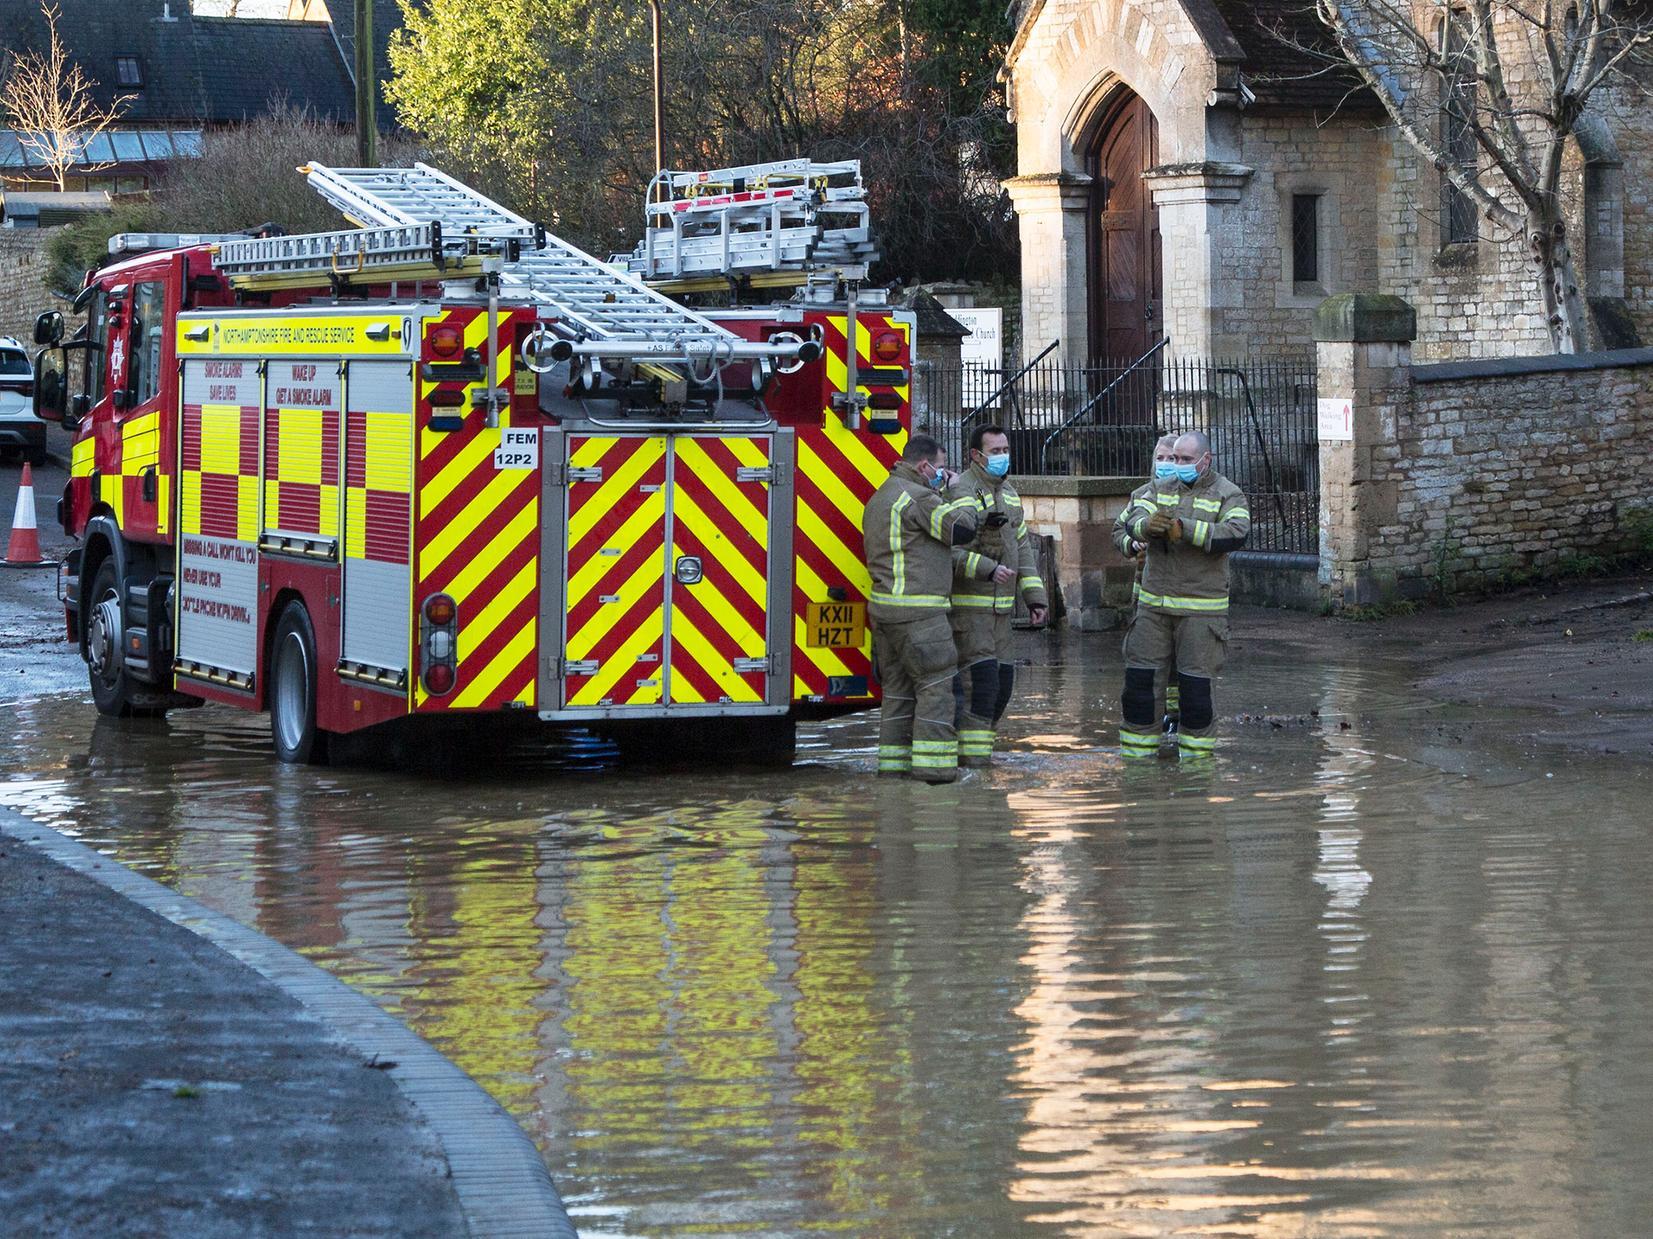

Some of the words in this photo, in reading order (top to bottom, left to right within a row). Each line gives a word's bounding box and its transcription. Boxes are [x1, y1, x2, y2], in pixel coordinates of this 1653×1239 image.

[223, 328, 278, 344] NORTHAMPTONSHIRE
[279, 327, 292, 343] FIRE
[293, 327, 304, 343] AND
[306, 326, 328, 343] RESCUE
[330, 326, 354, 343] SERVICE
[976, 327, 996, 340] Church
[205, 361, 222, 378] SMOKE
[223, 361, 242, 378] ALARMS
[292, 365, 307, 381] WAKE
[308, 365, 316, 381] UP
[210, 385, 222, 400] SAVE
[223, 385, 236, 400] LIVES
[276, 388, 287, 404] GET
[287, 388, 292, 404] A
[292, 388, 312, 405] SMOKE
[313, 389, 332, 406] ALARM
[507, 433, 537, 445] FEM
[496, 454, 532, 465] 12P2
[820, 606, 853, 623] KX11
[818, 628, 853, 645] HZT
